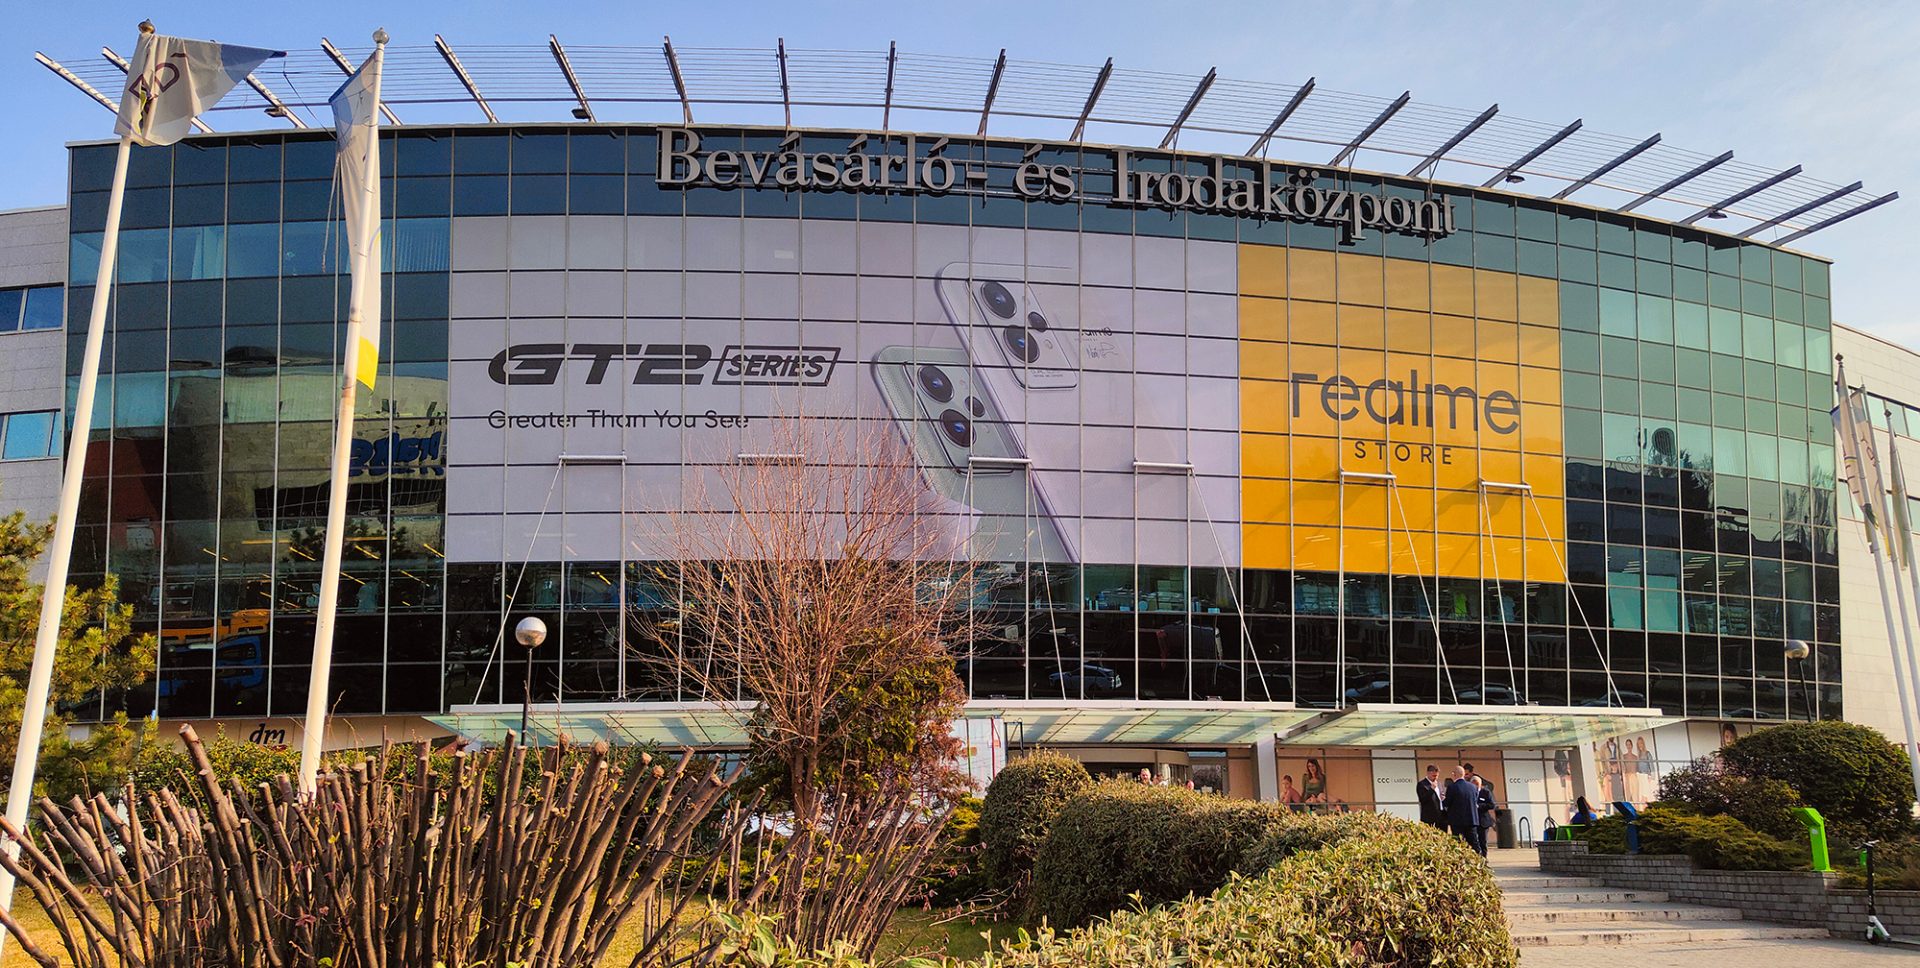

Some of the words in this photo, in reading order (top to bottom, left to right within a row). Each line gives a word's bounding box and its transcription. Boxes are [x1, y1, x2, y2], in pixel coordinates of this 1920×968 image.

[656, 128, 988, 191] Bevásárló-
[1014, 144, 1076, 198] és
[1114, 150, 1458, 240] Irodaközpont
[488, 343, 712, 386] GT2
[726, 354, 827, 378] SERIES
[1291, 368, 1521, 435] realme
[487, 409, 578, 430] Greater
[586, 409, 647, 429] Than
[653, 409, 697, 430] You
[704, 409, 750, 430] See
[1354, 440, 1453, 466] STORE
[249, 722, 286, 745] dm
